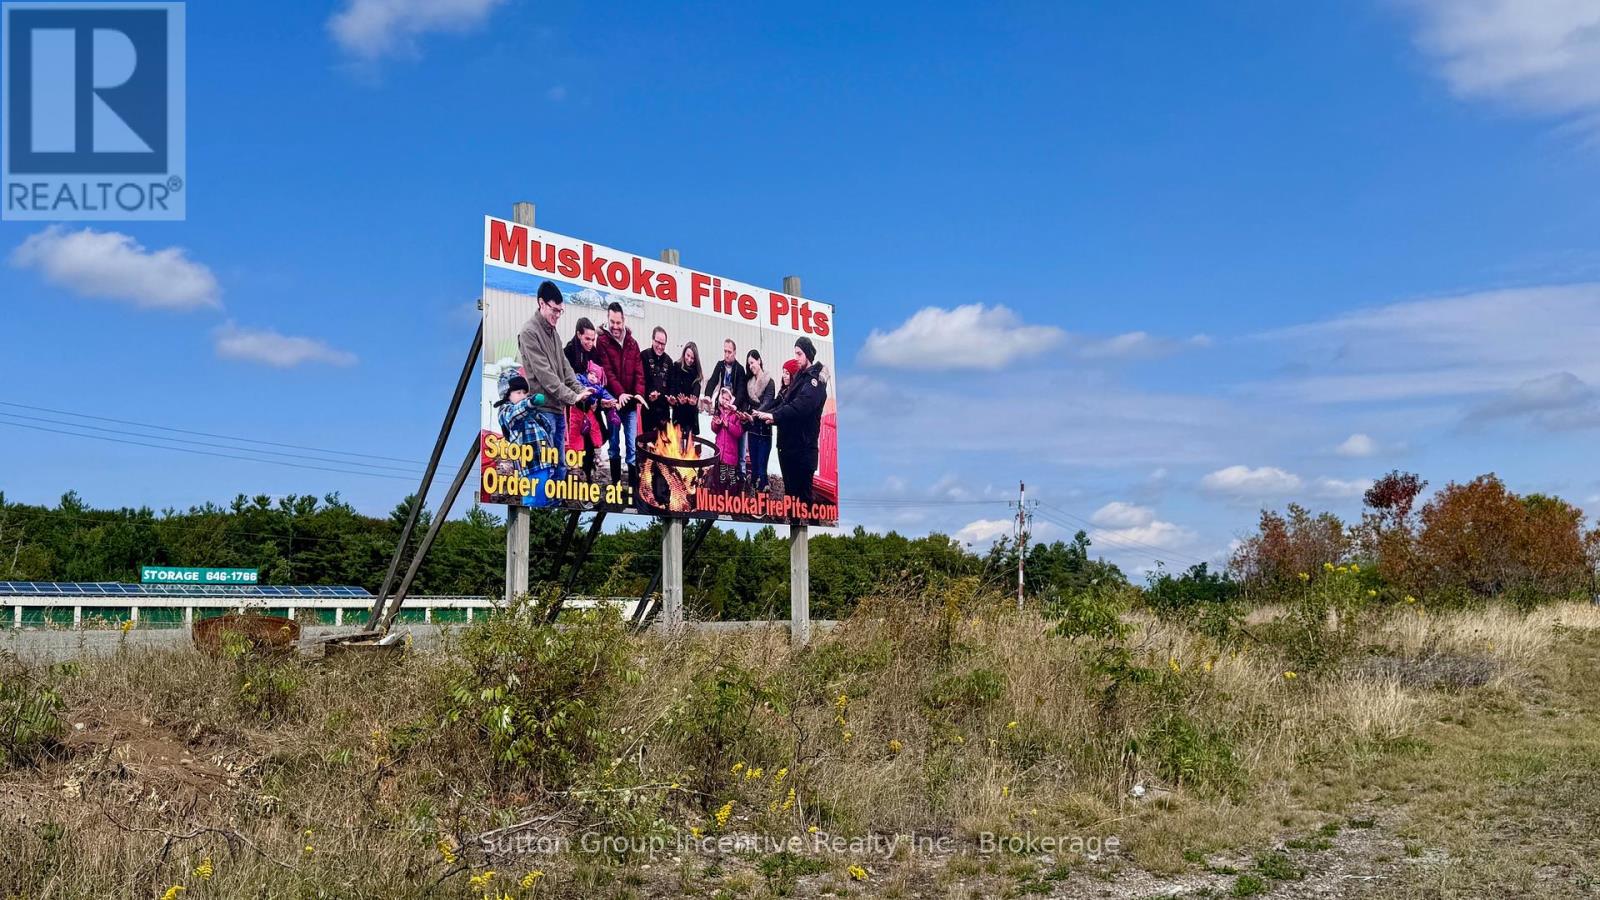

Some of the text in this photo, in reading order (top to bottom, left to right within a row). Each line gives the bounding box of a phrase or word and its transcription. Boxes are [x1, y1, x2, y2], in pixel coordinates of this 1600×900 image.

[489, 219, 830, 338] Muskoka Fire Pits
[484, 434, 586, 468] Stop in or
[483, 465, 537, 497] Order
[544, 474, 601, 504] online
[696, 488, 837, 521] MuskokaFirePits.com
[143, 570, 199, 581] STORAGE
